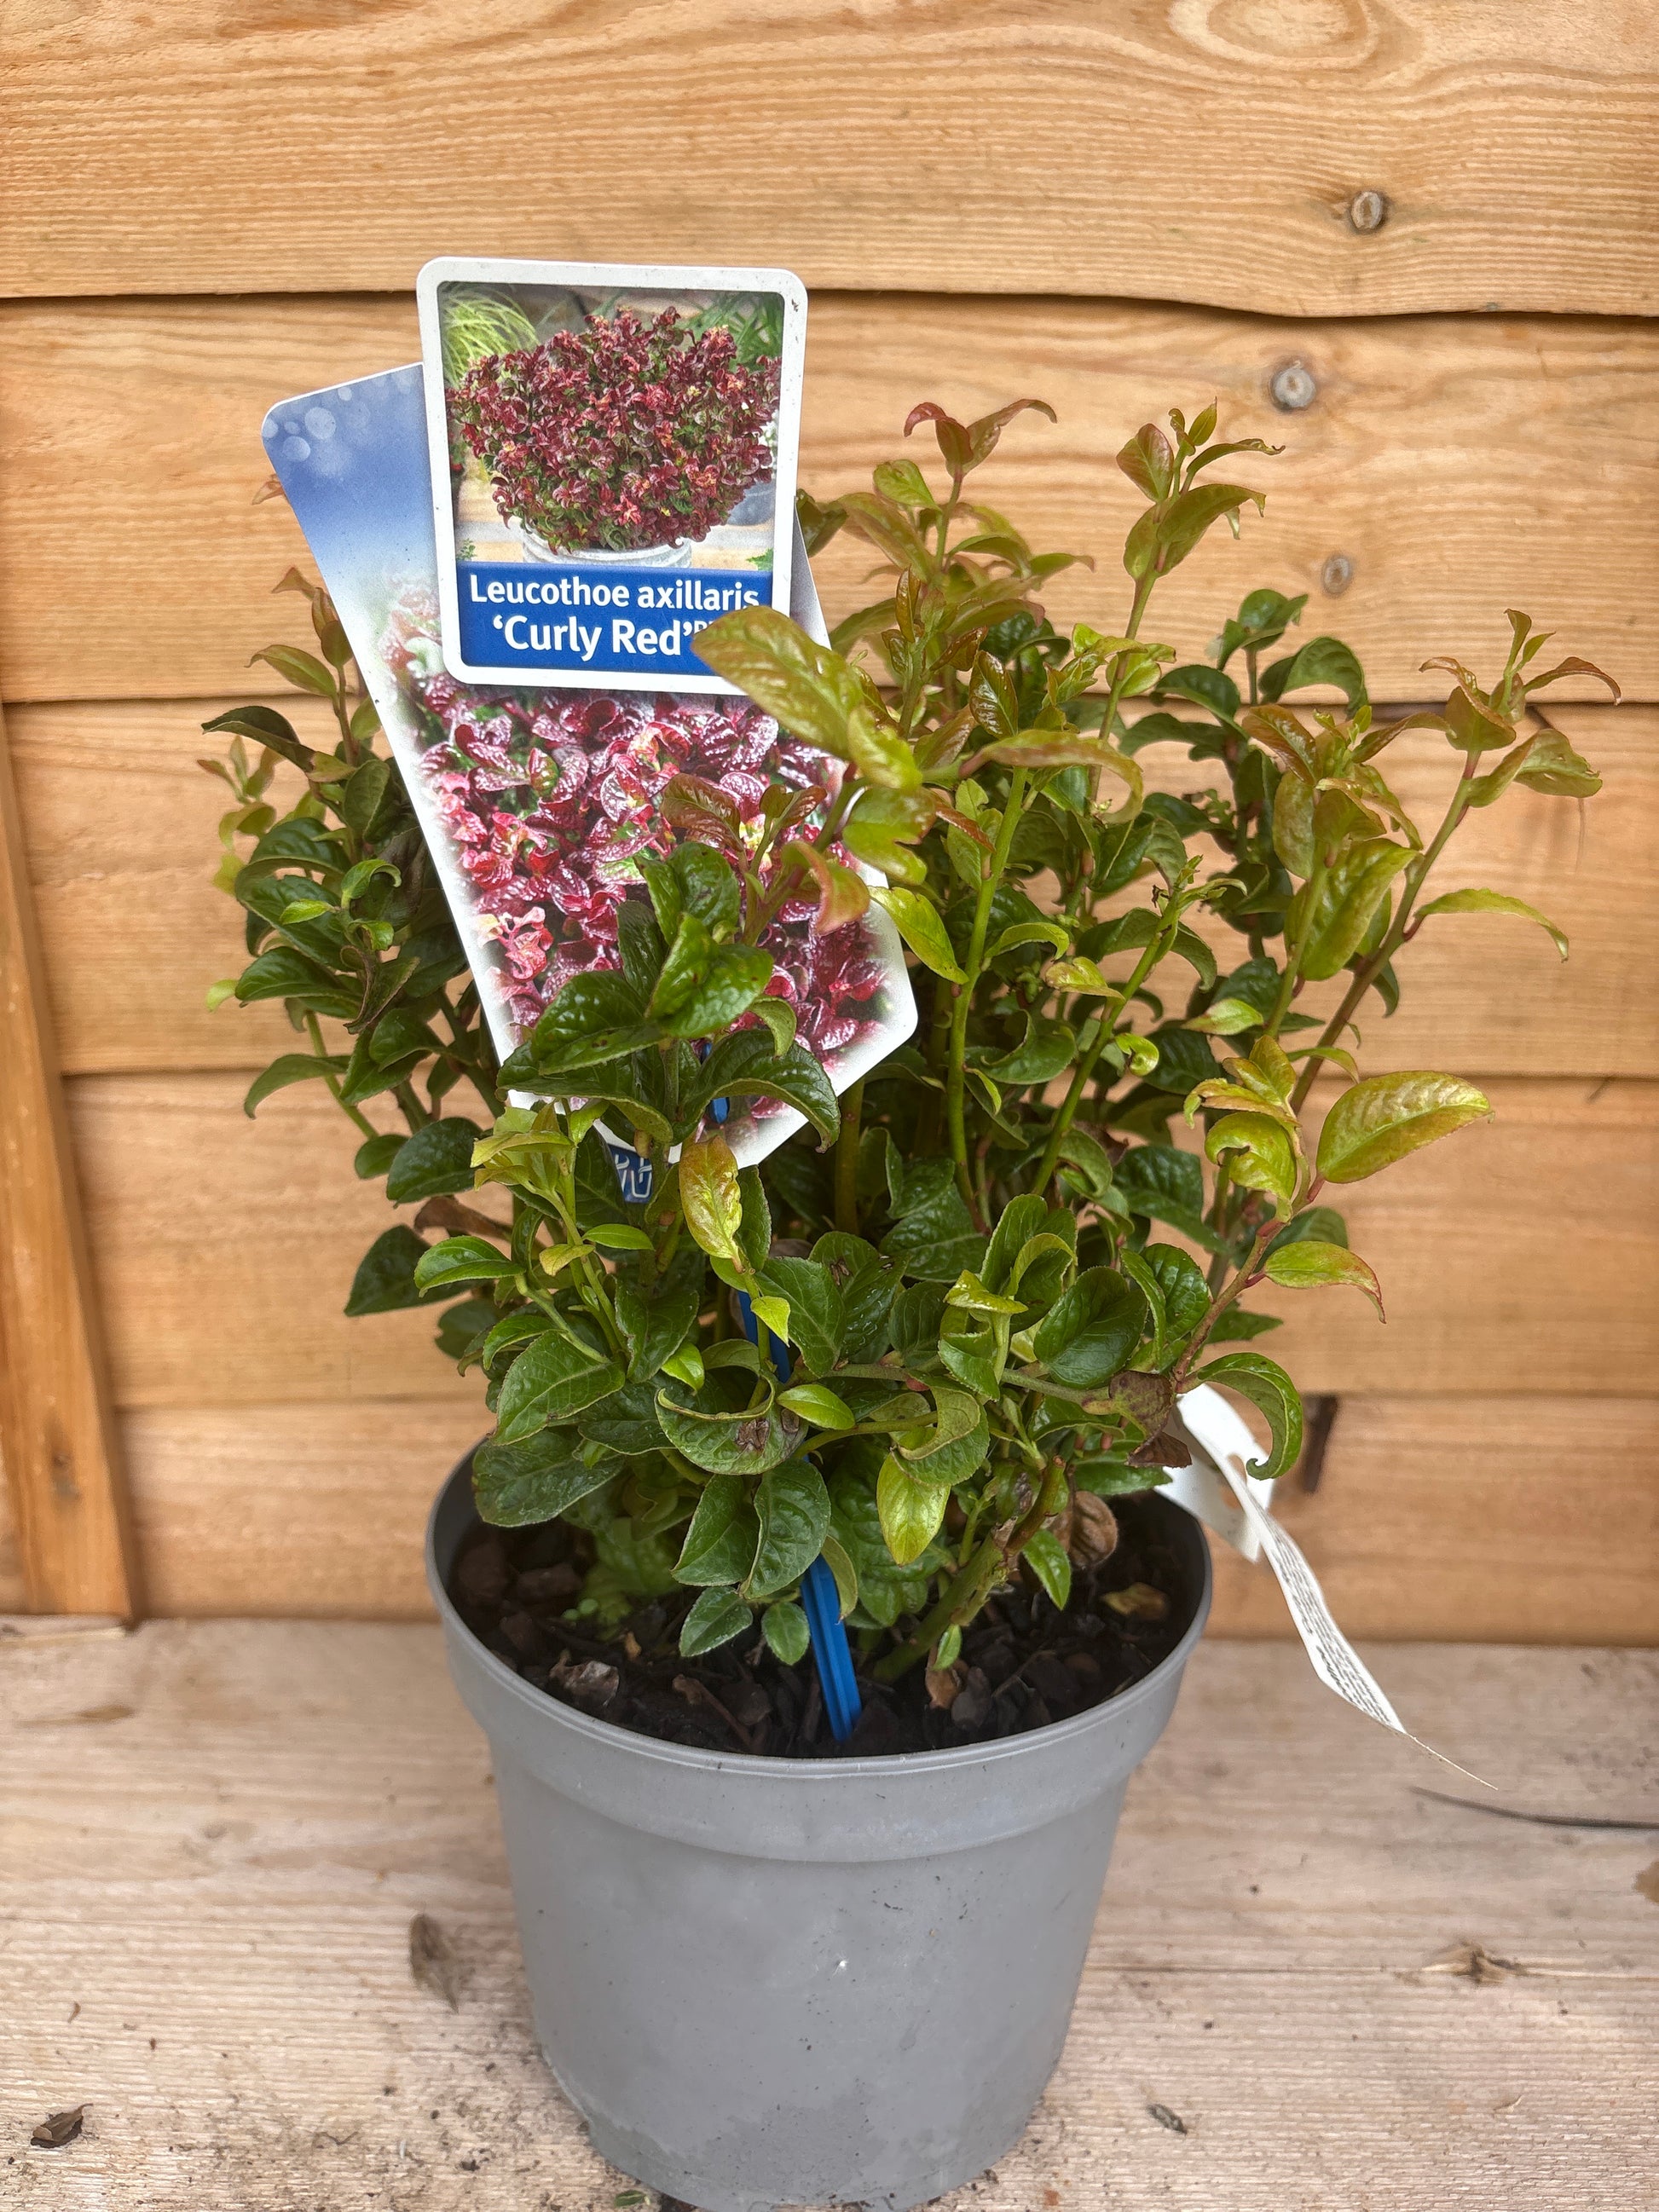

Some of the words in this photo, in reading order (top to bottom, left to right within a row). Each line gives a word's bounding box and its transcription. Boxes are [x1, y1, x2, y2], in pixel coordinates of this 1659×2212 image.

[470, 574, 630, 607] Leucothoe
[637, 579, 760, 611] axillaris
[493, 614, 603, 662] ‘Curly
